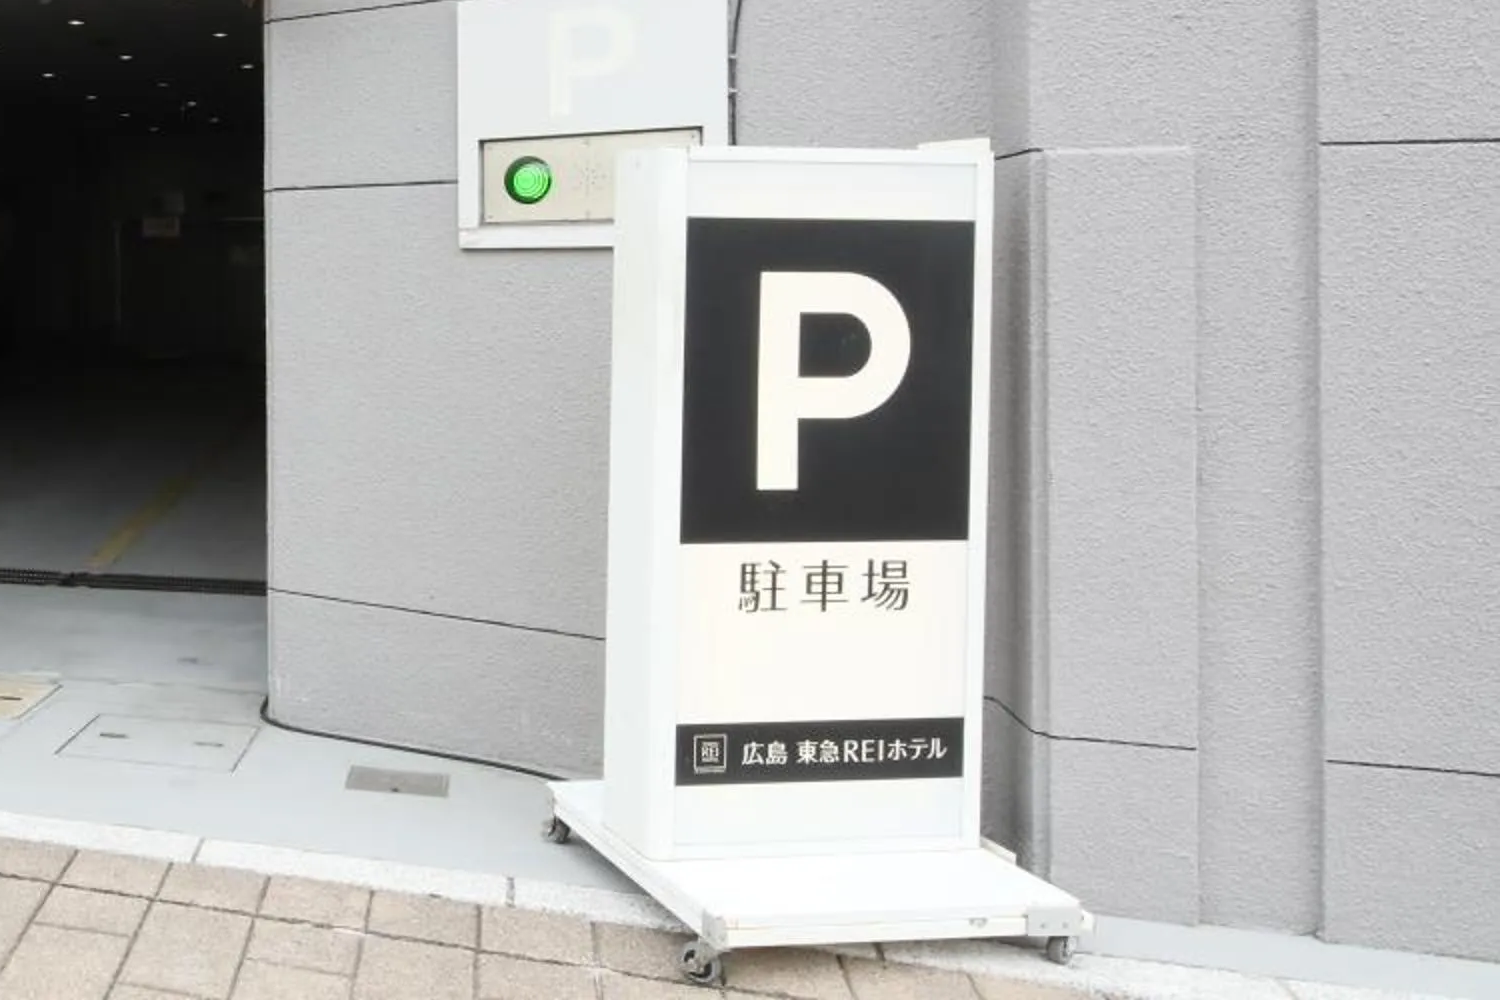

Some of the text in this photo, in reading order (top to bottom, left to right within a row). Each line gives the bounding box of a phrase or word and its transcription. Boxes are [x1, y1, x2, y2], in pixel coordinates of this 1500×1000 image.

[550, 5, 639, 116] P
[755, 271, 911, 491] P
[738, 558, 911, 613] 駐車場
[741, 737, 947, 765] 広島 東急REIホテル
